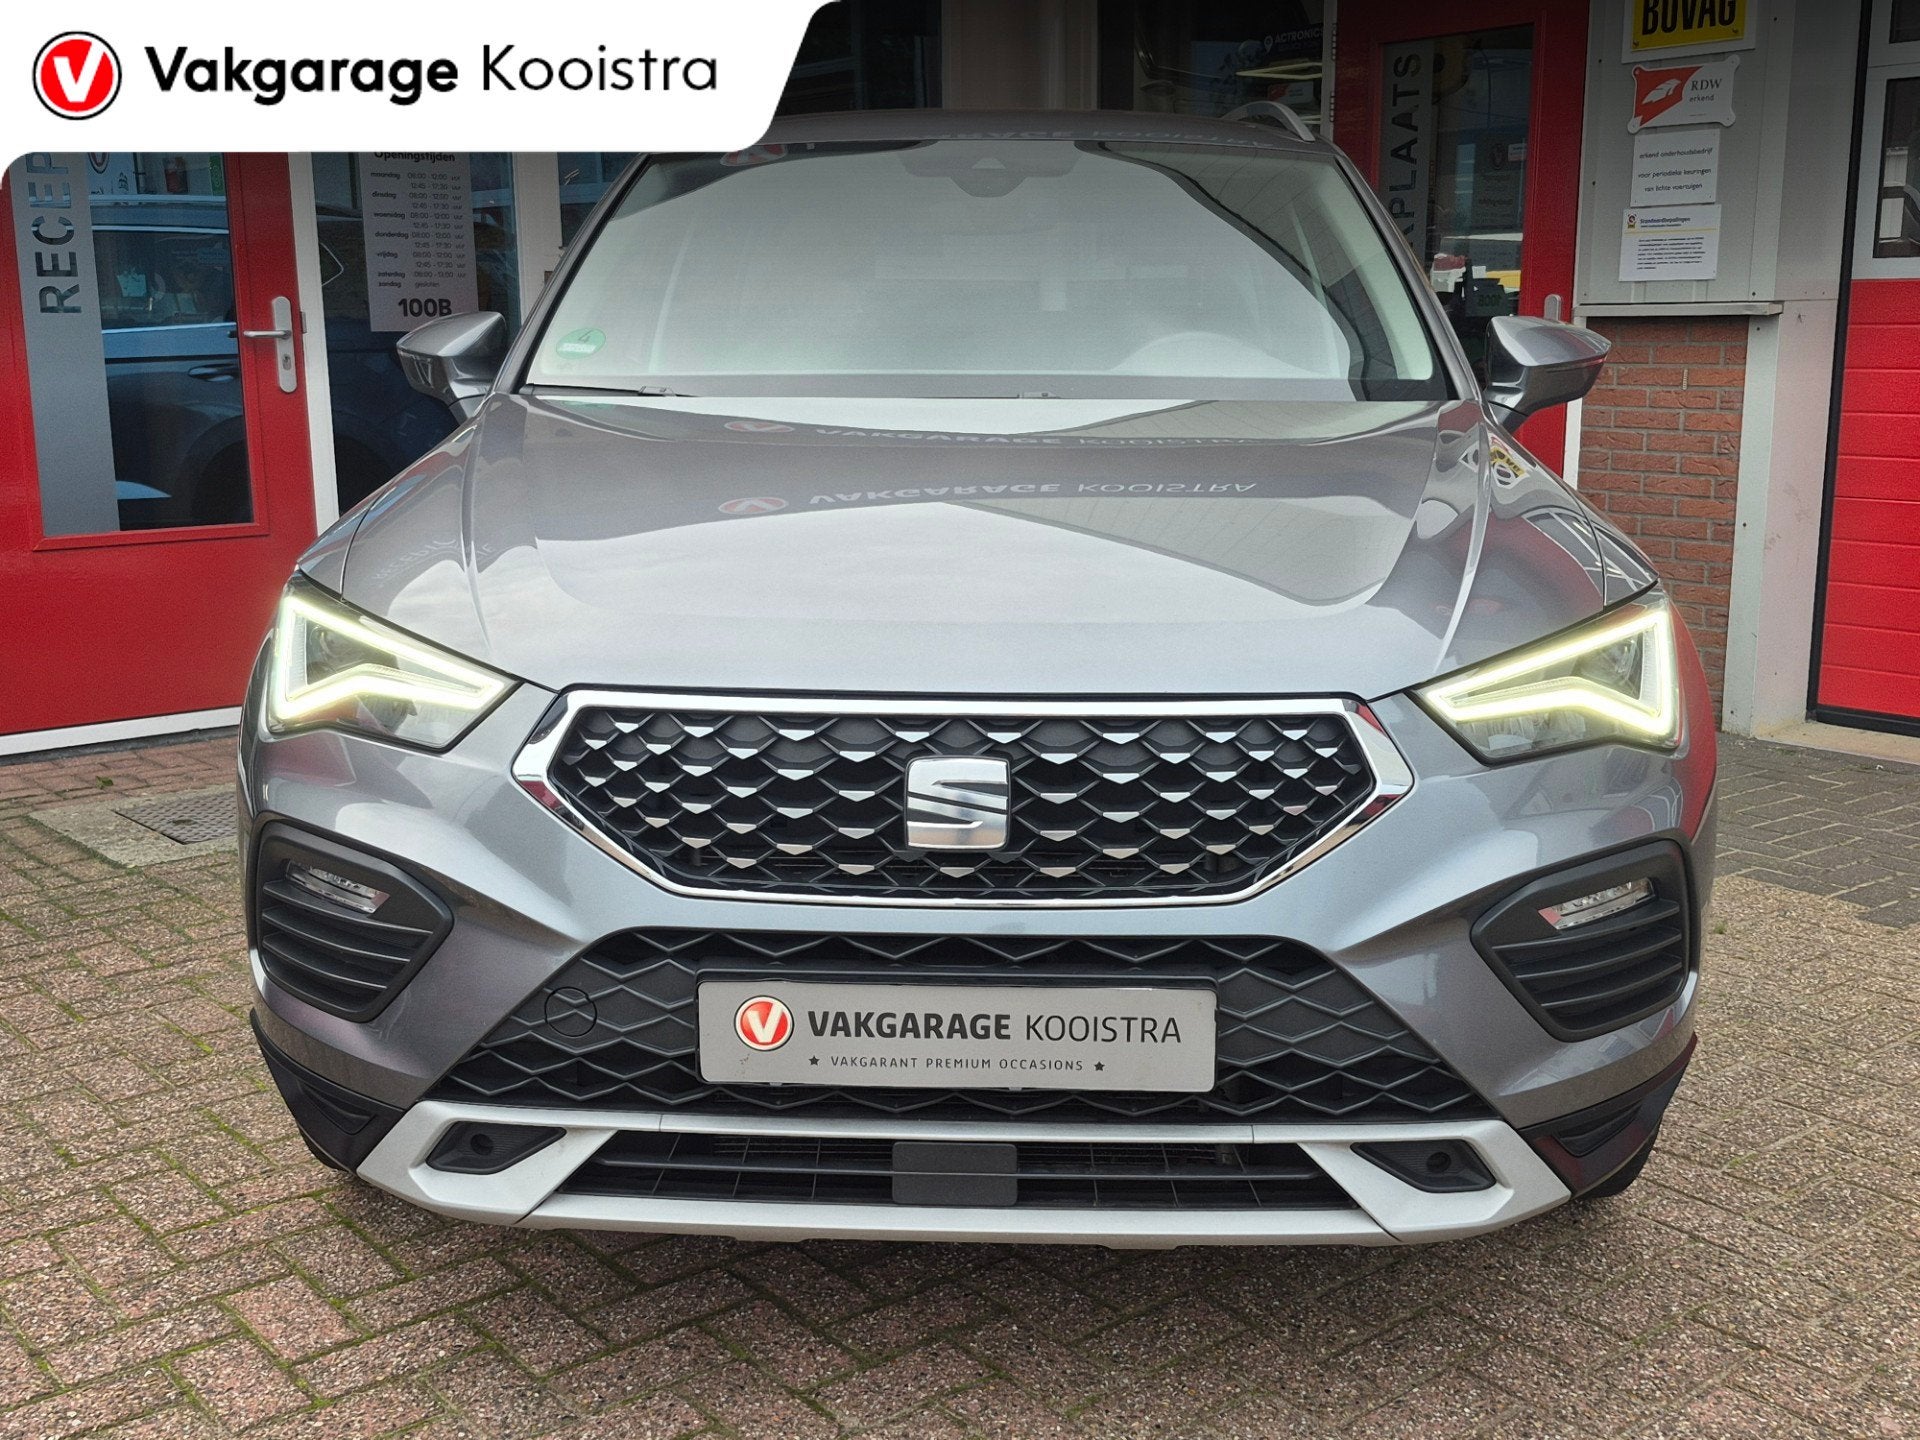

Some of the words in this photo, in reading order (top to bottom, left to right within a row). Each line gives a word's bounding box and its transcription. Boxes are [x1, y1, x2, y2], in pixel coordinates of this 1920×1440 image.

[1642, 0, 1736, 35] BOVAG
[1690, 78, 1722, 92] RDW
[1689, 94, 1715, 103] erkend
[374, 152, 456, 163] Openingstijden
[398, 298, 453, 318] 100B
[808, 1011, 1011, 1040] VAKGARAGE
[1026, 1014, 1182, 1044] KOOISTRA
[831, 1056, 917, 1068] VAKGARANT
[926, 1057, 991, 1069] PREMIUM
[999, 1058, 1083, 1071] OCCASIONS
